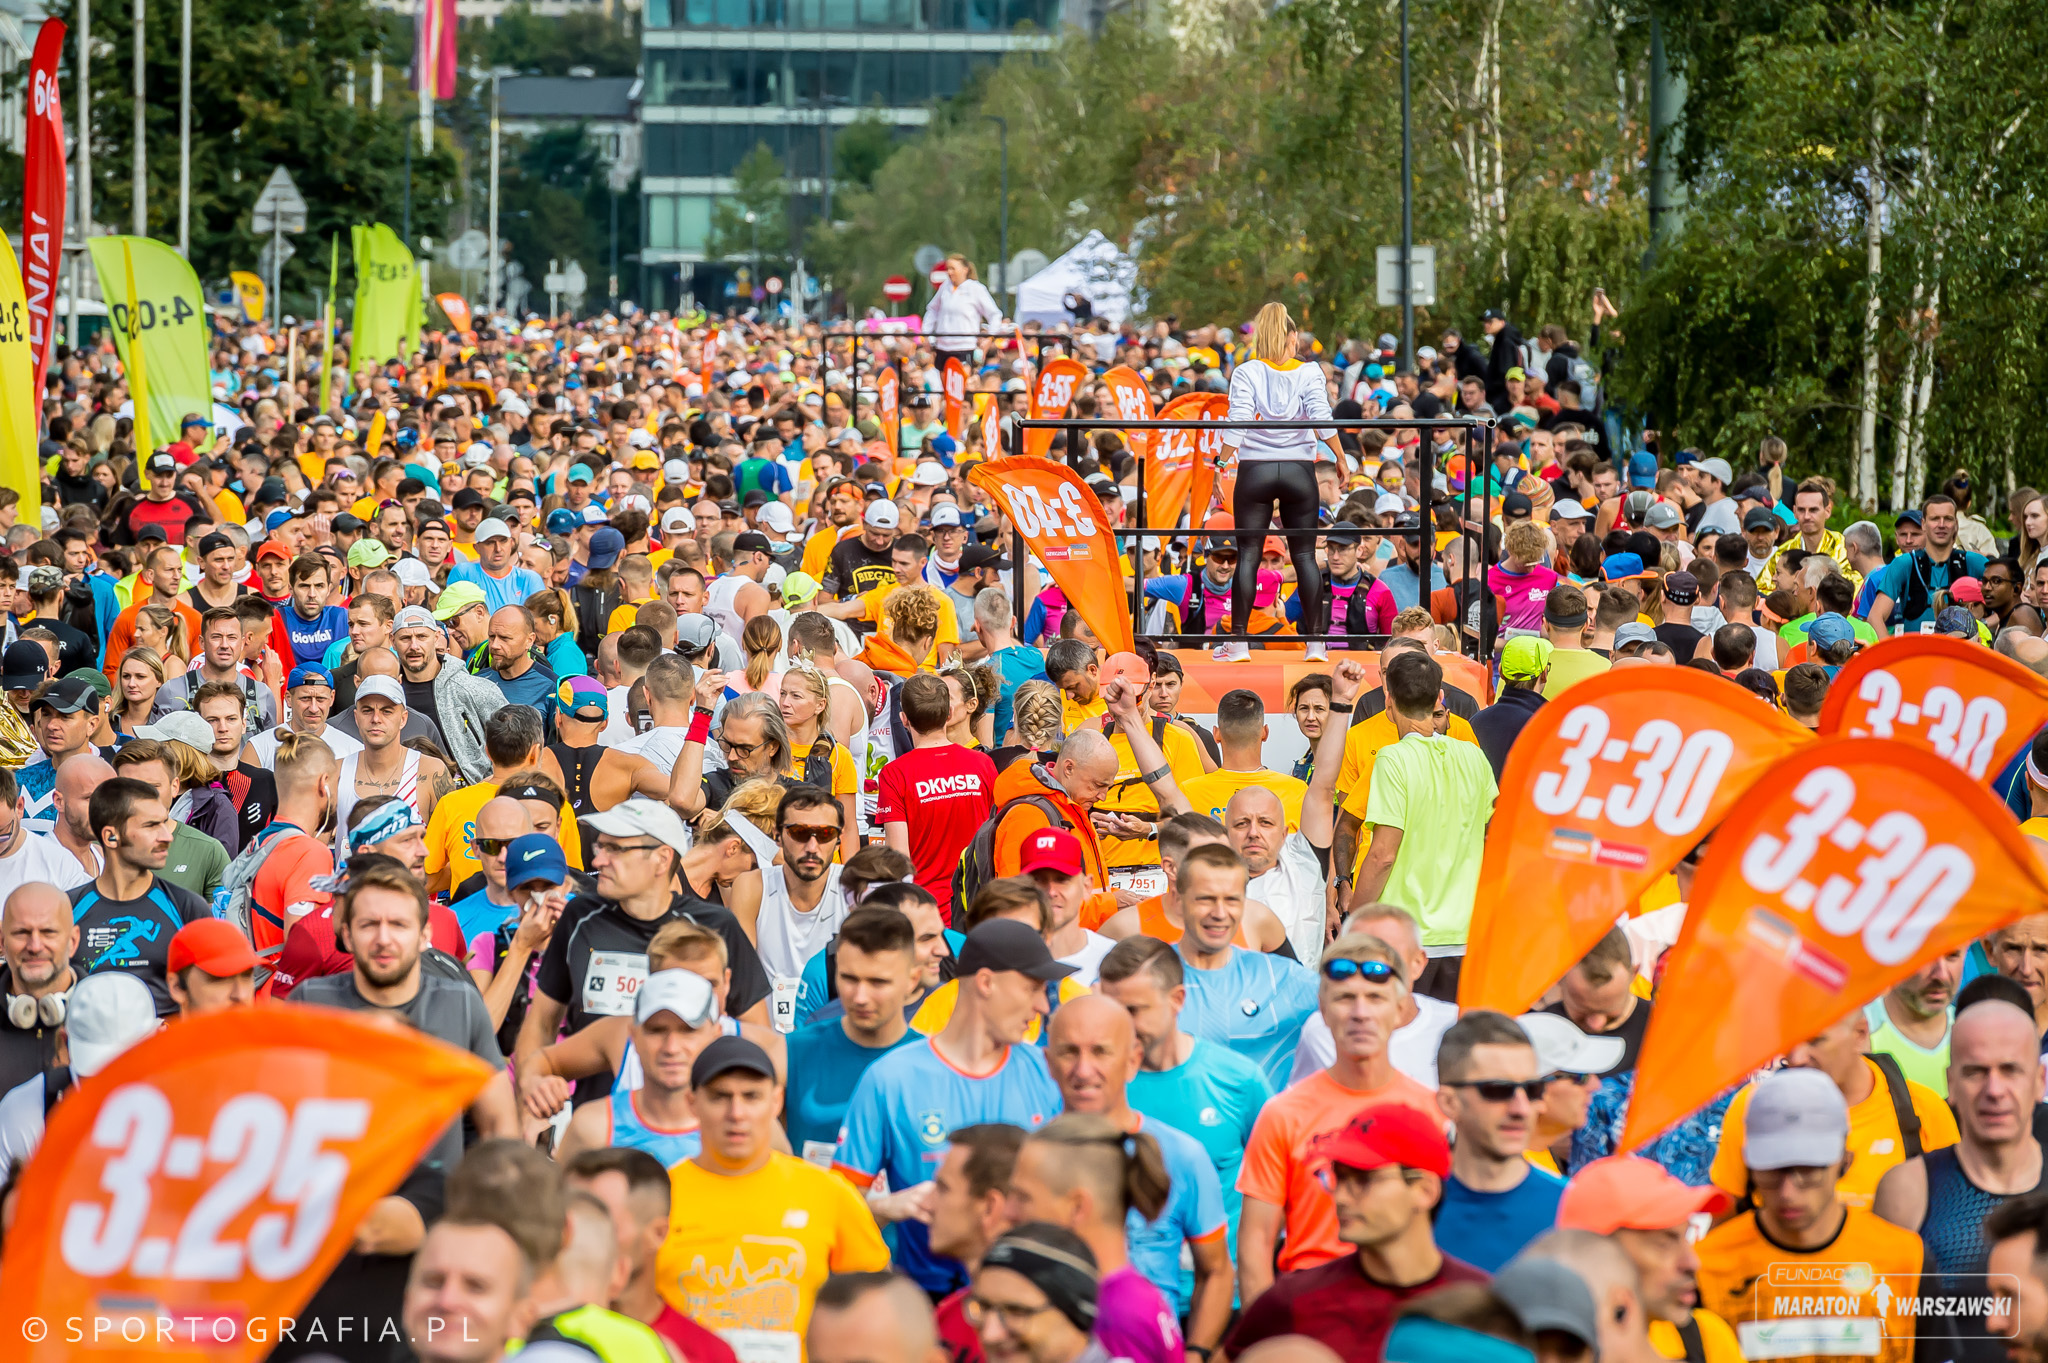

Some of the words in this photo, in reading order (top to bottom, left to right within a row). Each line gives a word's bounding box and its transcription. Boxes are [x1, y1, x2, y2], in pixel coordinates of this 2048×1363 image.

[1037, 372, 1076, 408] 3:55
[915, 774, 967, 798] DKMS
[1532, 704, 1735, 836] 3:30
[1130, 878, 1156, 889] 7951
[1741, 765, 1976, 966] 3:30
[616, 975, 645, 993] 50
[60, 1082, 372, 1282] 3:25
